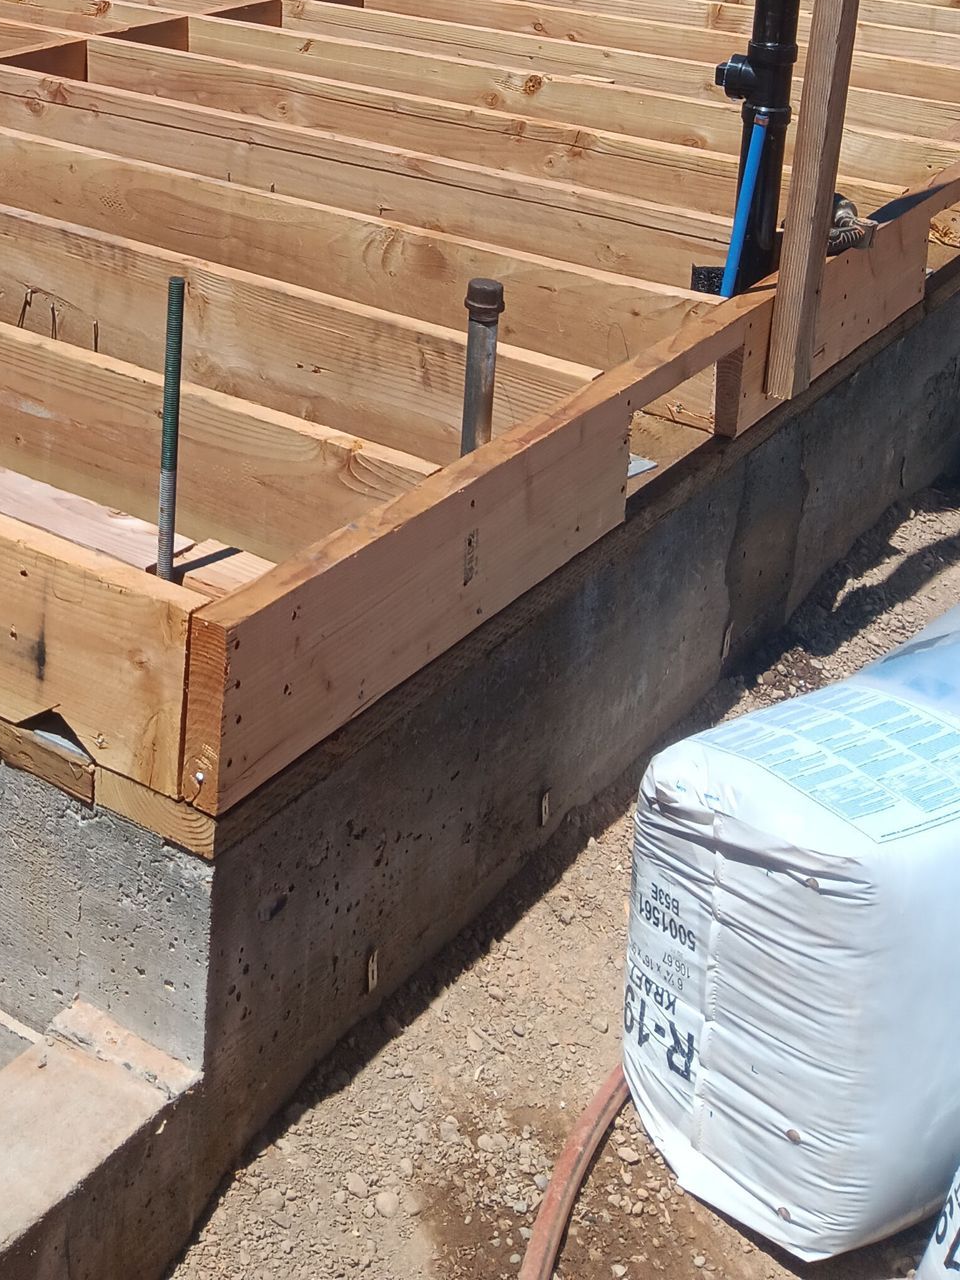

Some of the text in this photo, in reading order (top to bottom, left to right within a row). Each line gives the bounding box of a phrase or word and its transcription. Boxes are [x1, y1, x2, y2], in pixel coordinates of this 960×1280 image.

[651, 882, 680, 917] B53E
[640, 894, 696, 952] 5001561
[655, 963, 661, 972] x
[677, 978, 683, 991] 6
[624, 983, 695, 1082] R-19
